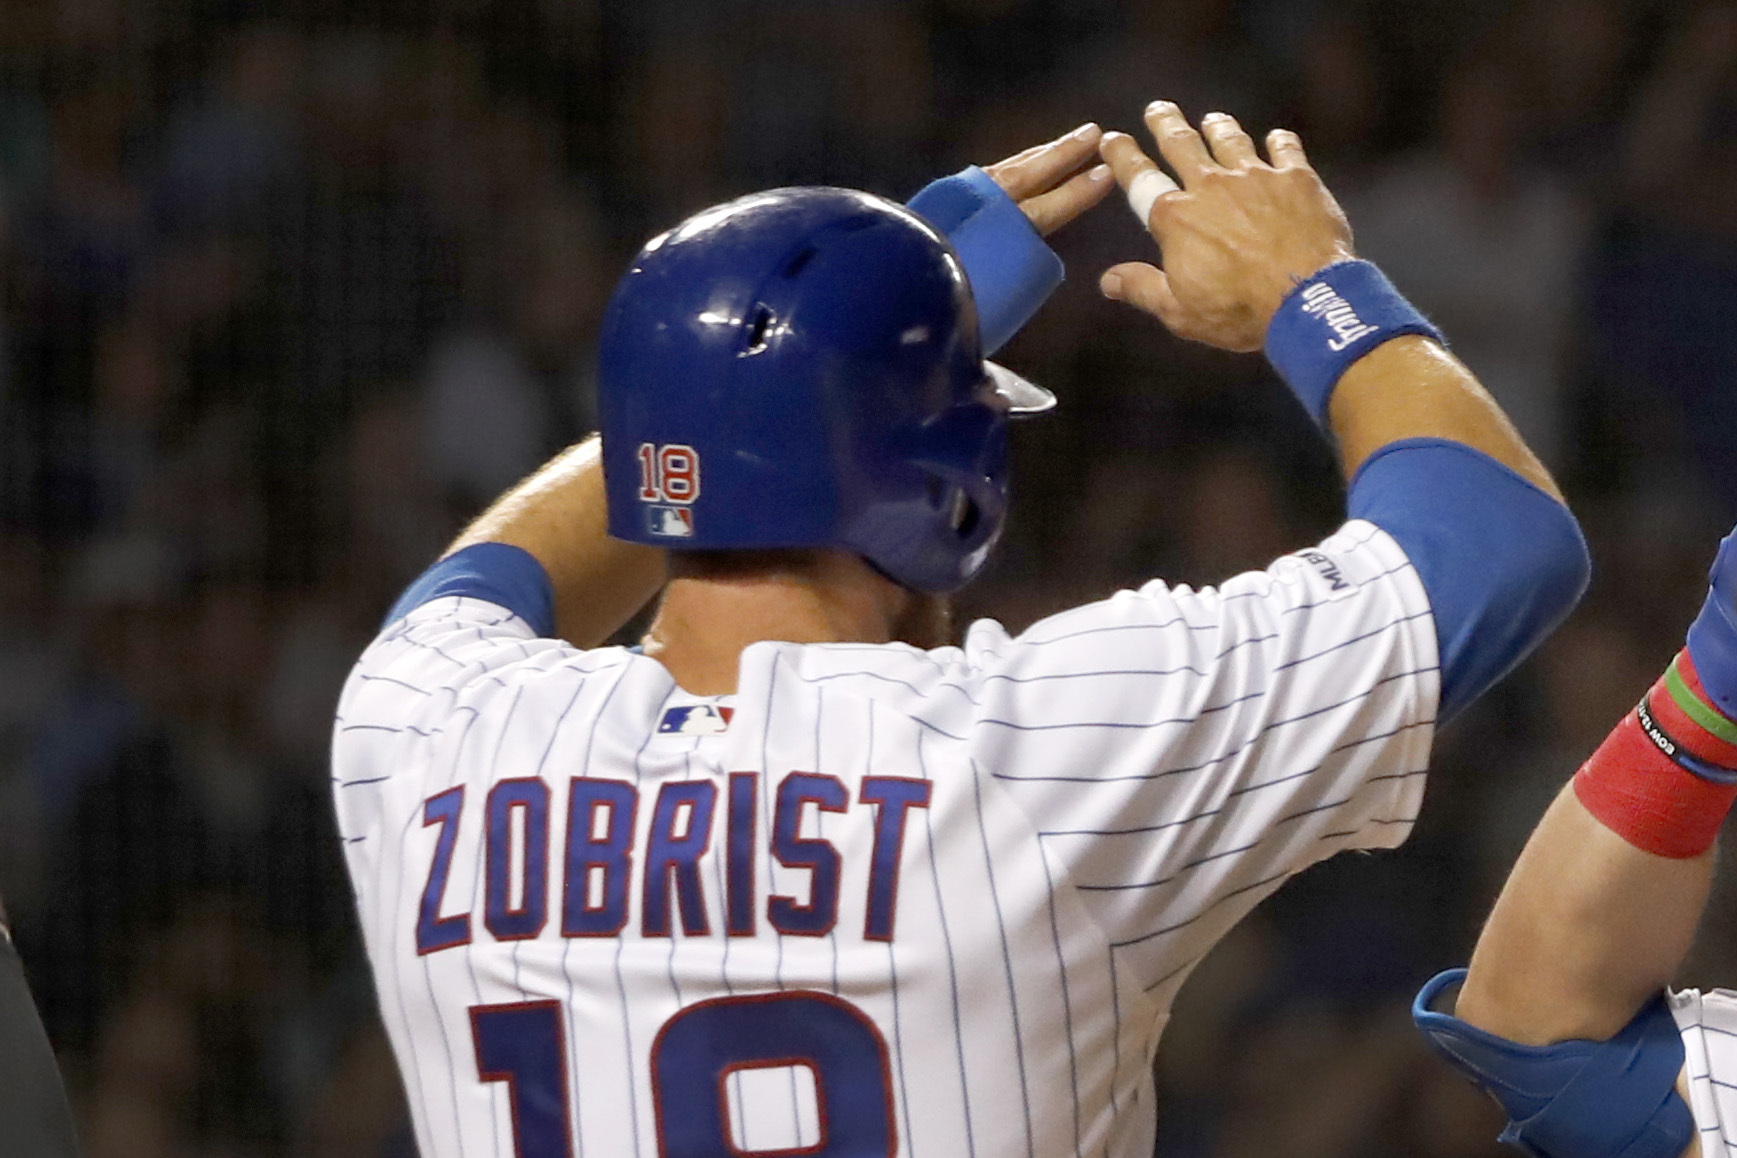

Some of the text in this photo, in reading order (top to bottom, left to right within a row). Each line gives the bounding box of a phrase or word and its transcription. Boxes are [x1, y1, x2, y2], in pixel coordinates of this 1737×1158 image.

[1302, 282, 1379, 351] Franklin
[639, 443, 701, 504] 18
[1649, 728, 1676, 756] EOW
[416, 771, 934, 957] ZOBRIST
